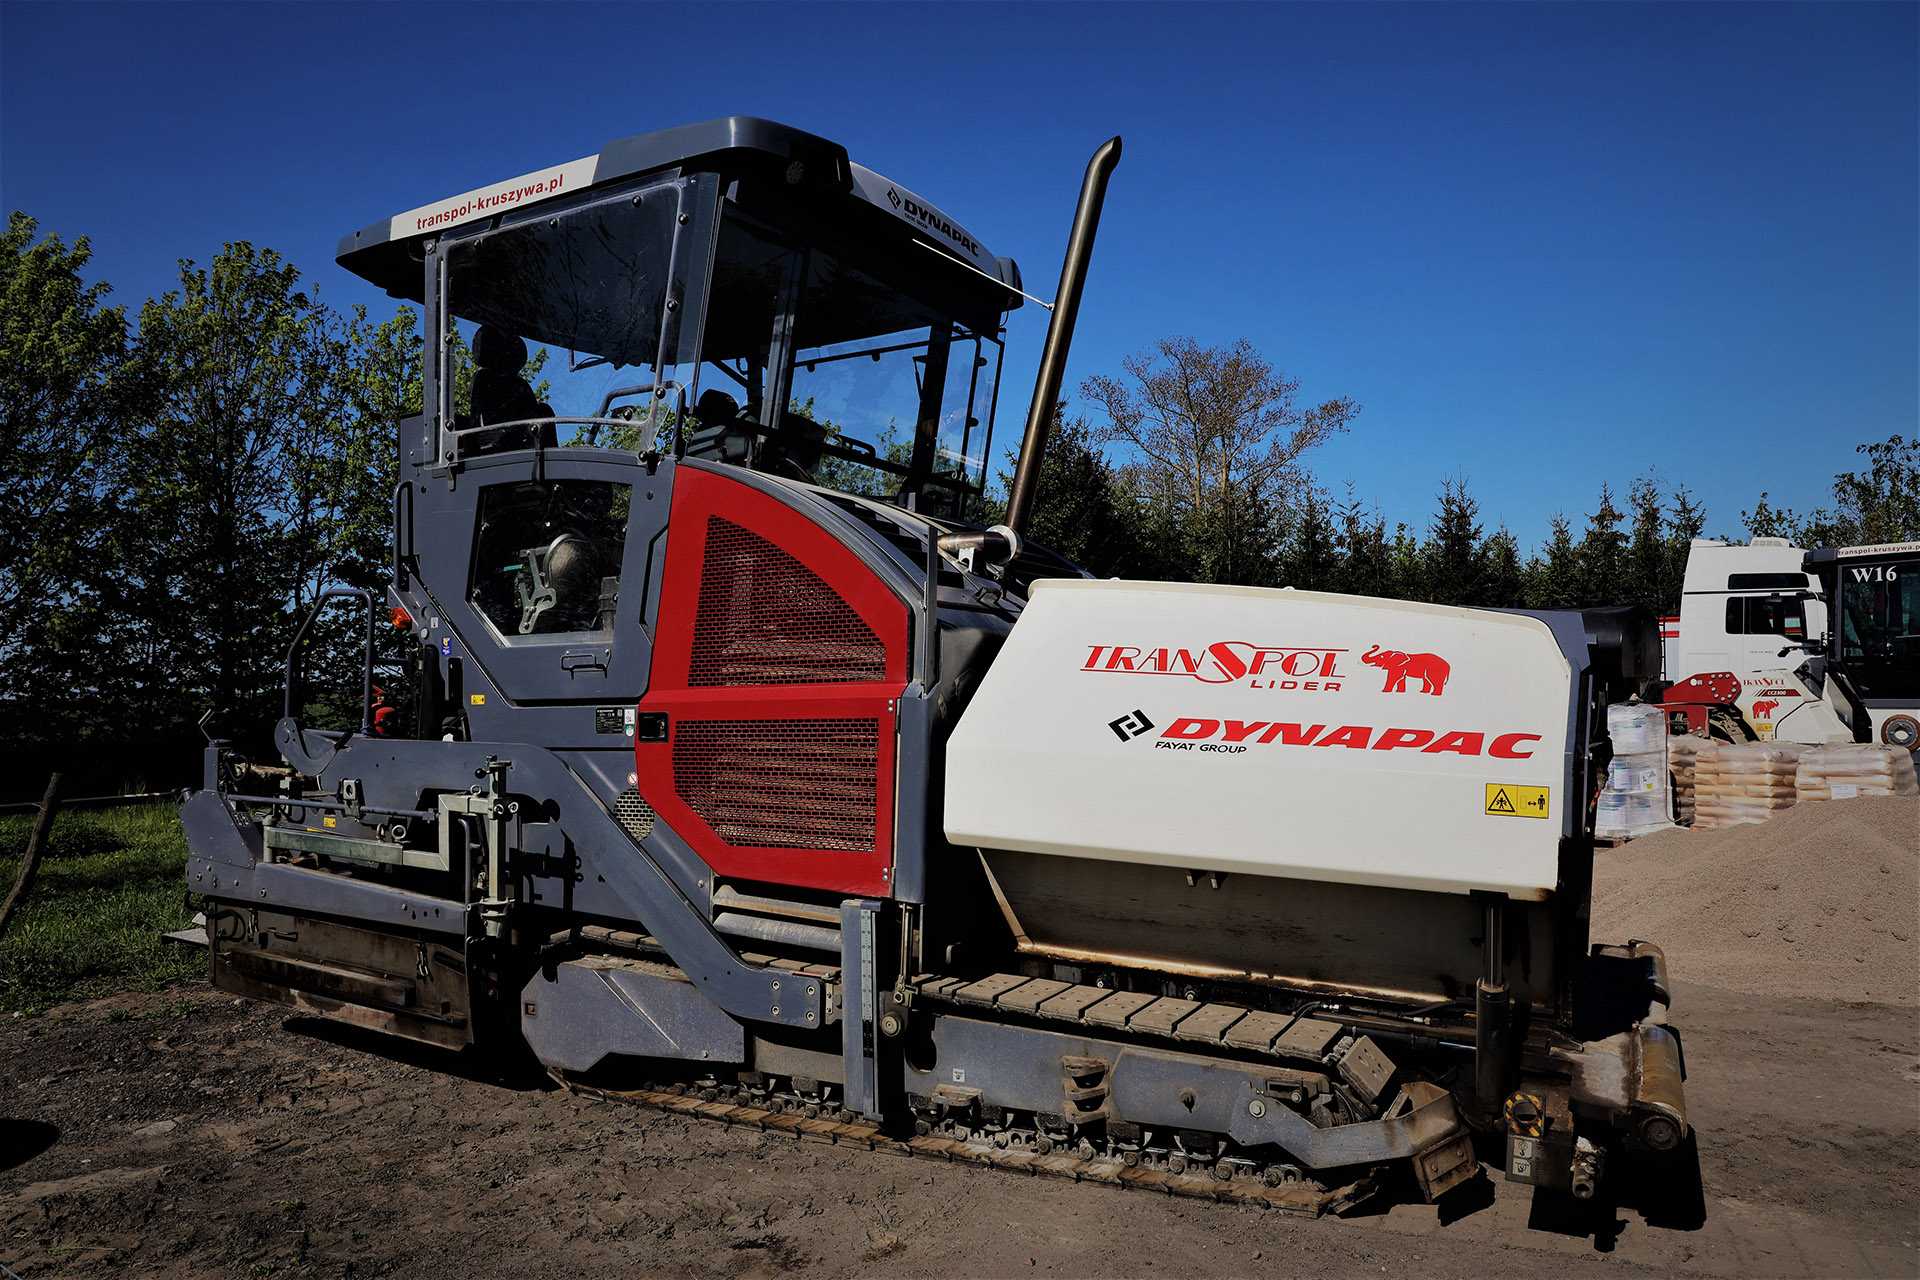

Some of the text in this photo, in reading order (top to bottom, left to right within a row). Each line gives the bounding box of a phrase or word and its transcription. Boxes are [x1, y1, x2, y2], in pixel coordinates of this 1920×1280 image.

[416, 173, 563, 230] transpol-kruszywa.pl
[903, 198, 979, 257] DYNAPAC
[1851, 565, 1897, 583] W16
[1080, 641, 1349, 683] TRANSPOL
[1250, 679, 1342, 692] LIDER
[1154, 740, 1247, 754] FAYAT GROUP
[1160, 717, 1543, 760] DYNAPAC
